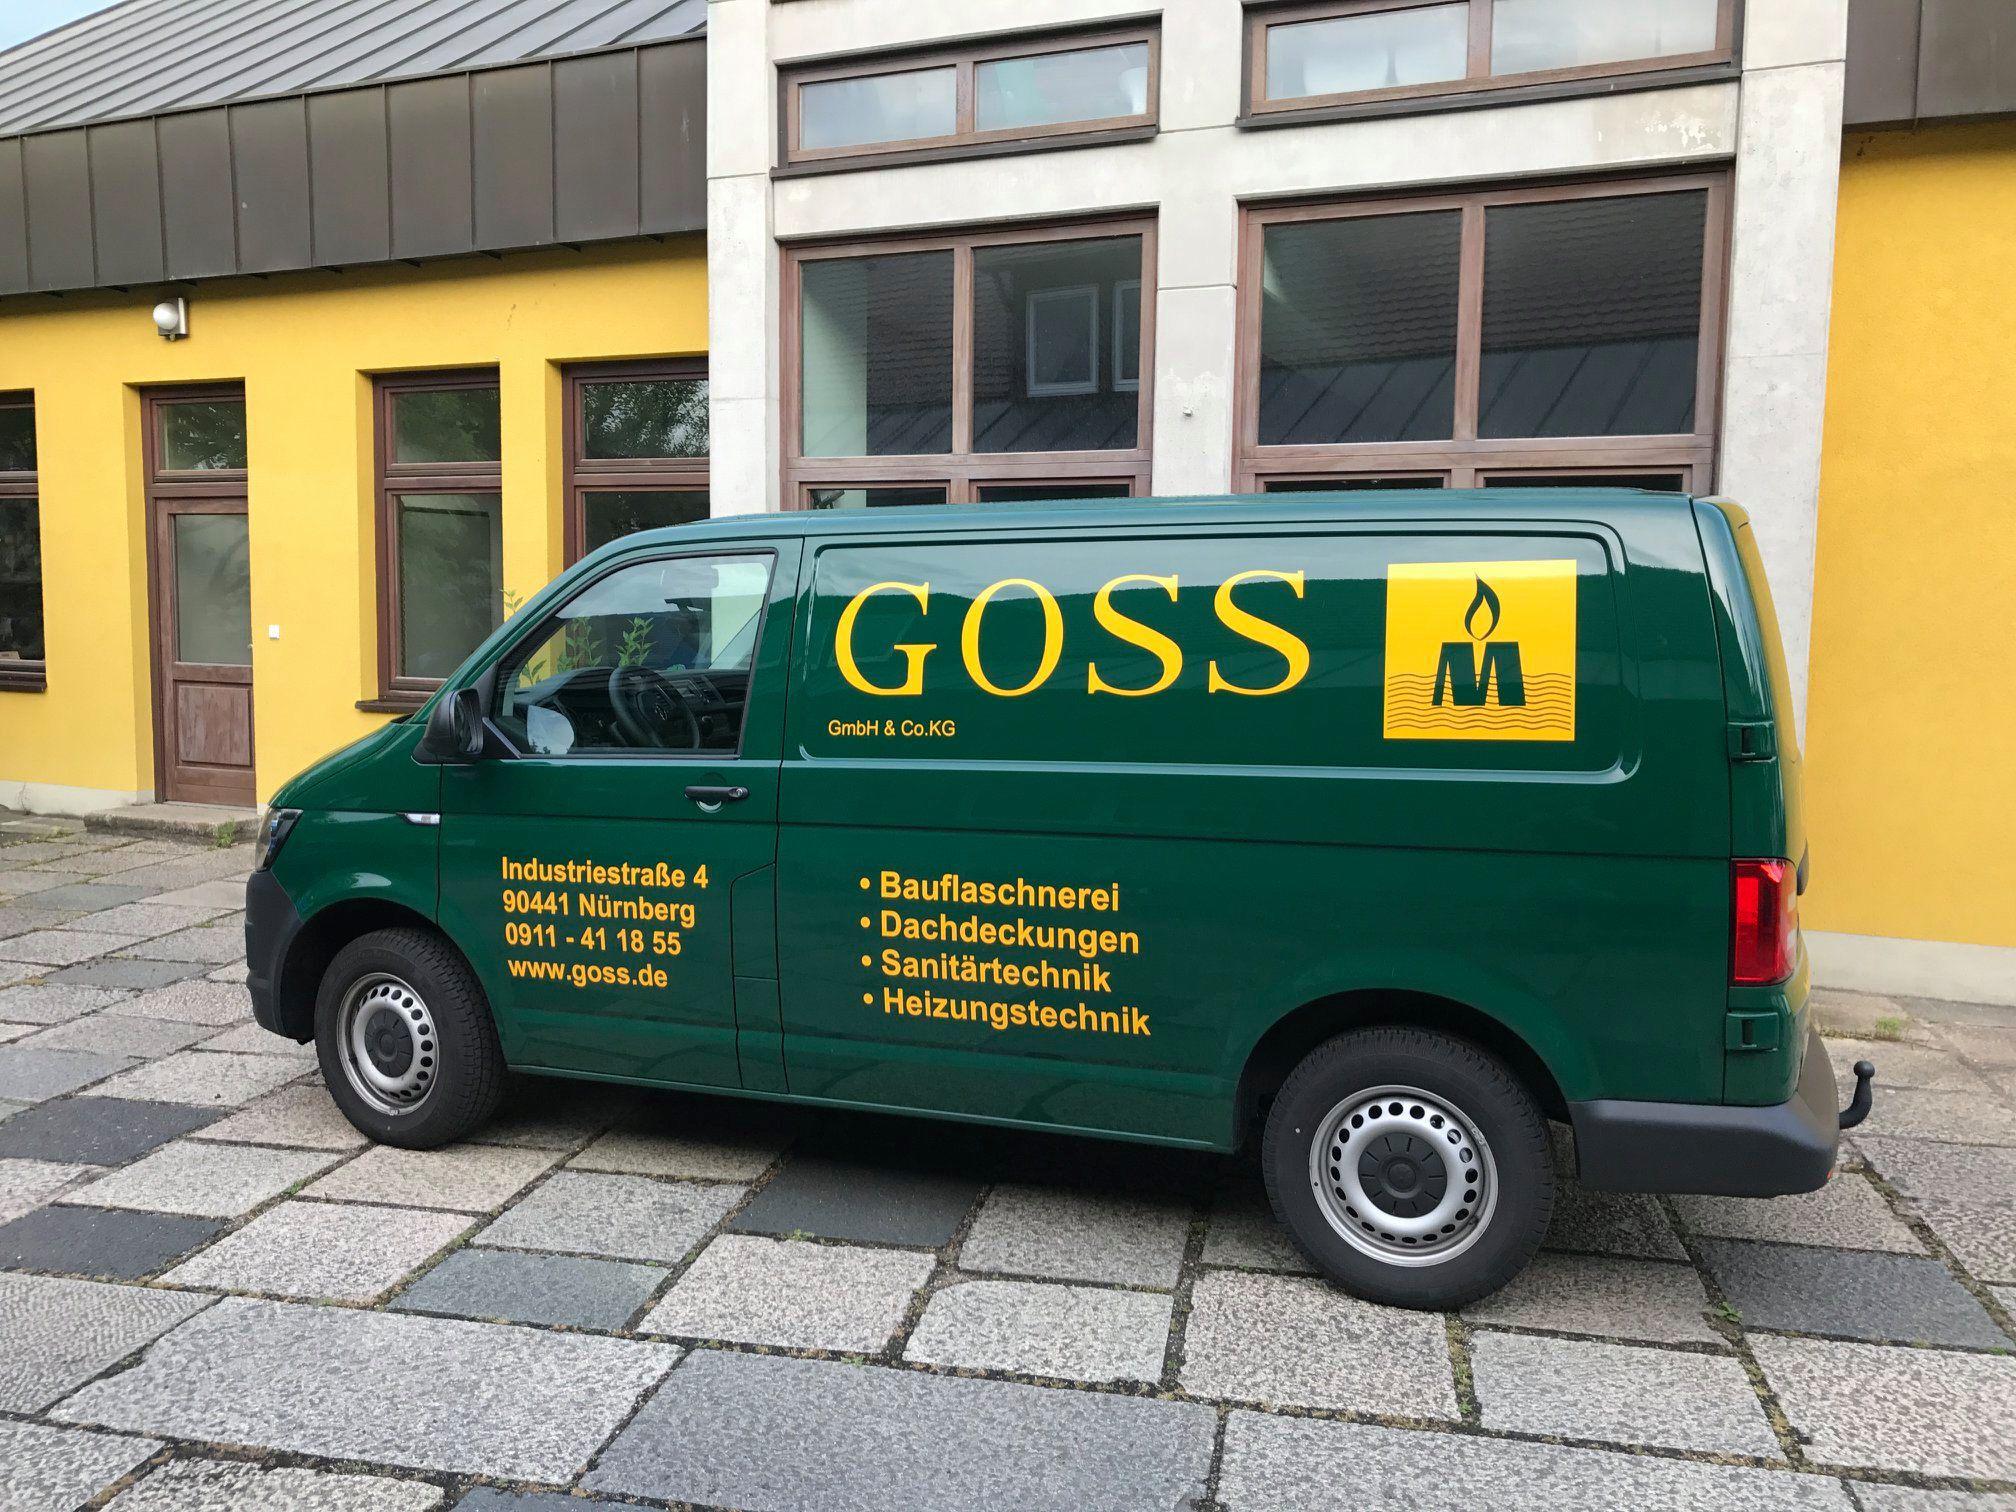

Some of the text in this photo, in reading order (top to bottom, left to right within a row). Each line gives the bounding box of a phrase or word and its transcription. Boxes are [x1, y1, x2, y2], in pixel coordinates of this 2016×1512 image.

[834, 569, 1310, 697] GOSS
[828, 719, 956, 737] GmbH & Co.KG
[502, 856, 709, 889] Industriestraße 4
[880, 870, 1119, 912] Bauflaschnerei
[502, 889, 696, 929] 90441 Nürnberg
[505, 922, 556, 948] 0911
[580, 926, 606, 951] 41
[616, 928, 645, 953] 18
[652, 930, 682, 956] 55
[881, 909, 1139, 959] Dachdeckungen
[507, 959, 668, 988] www.goss.de
[881, 948, 1112, 993] Sanitärtechnik
[883, 986, 1151, 1036] Heizungstechnik
